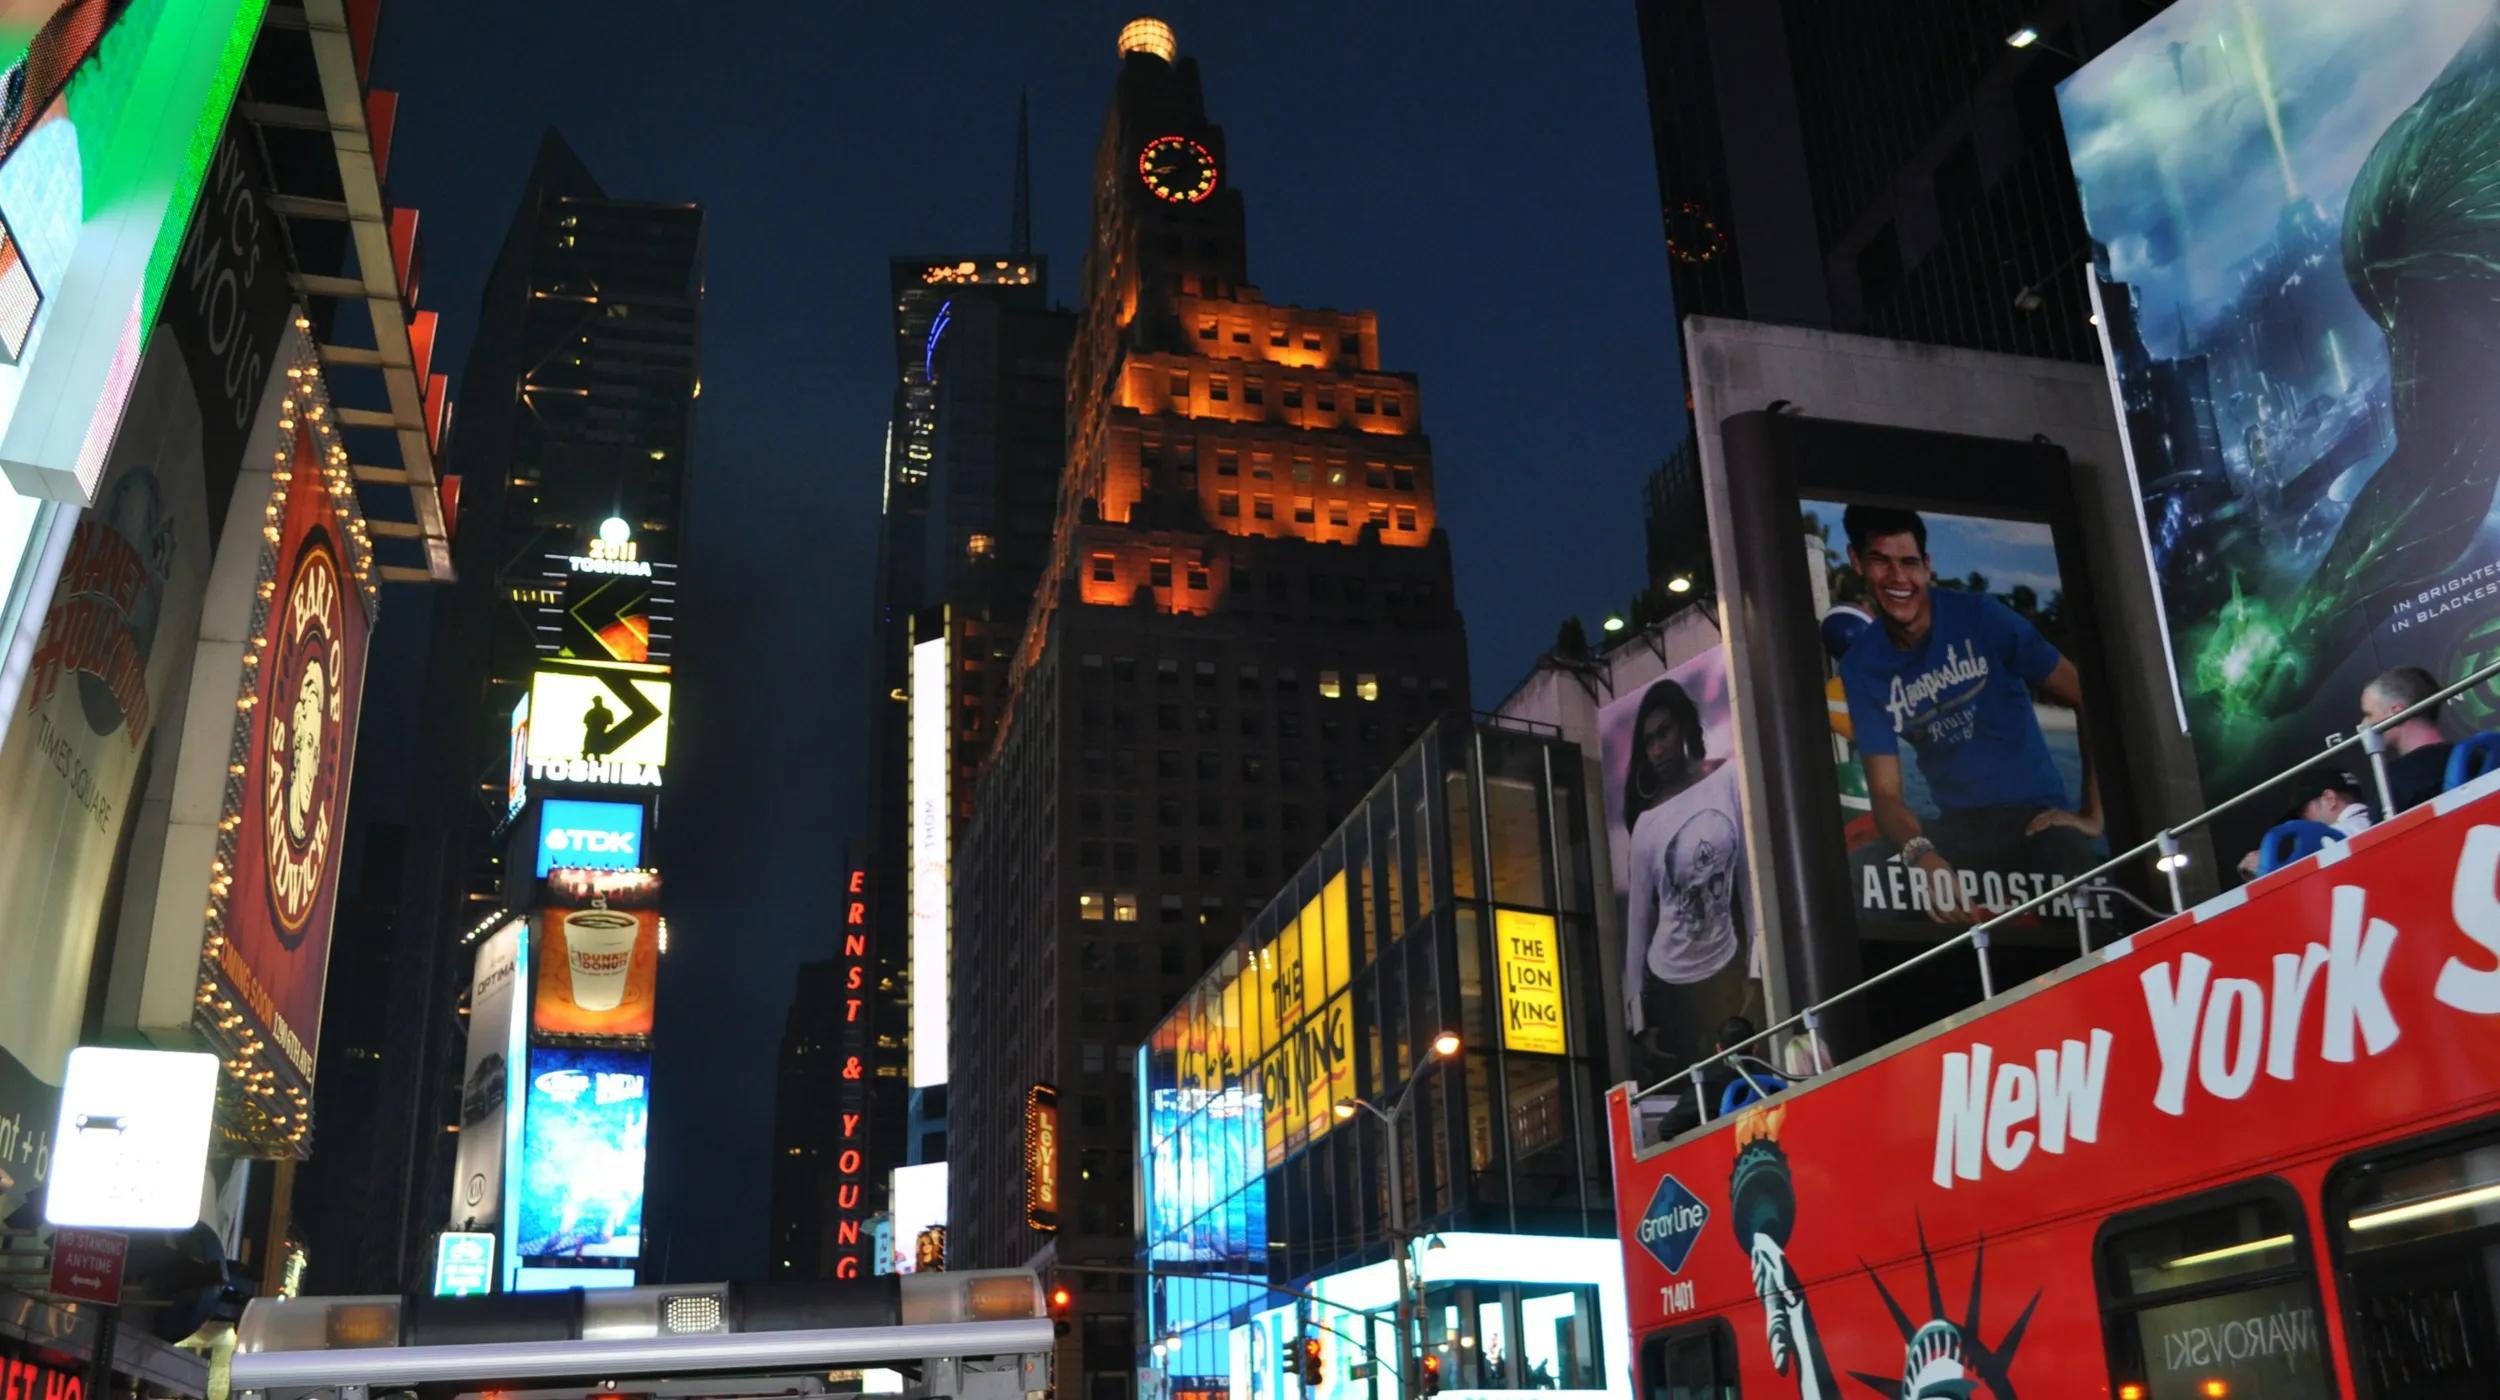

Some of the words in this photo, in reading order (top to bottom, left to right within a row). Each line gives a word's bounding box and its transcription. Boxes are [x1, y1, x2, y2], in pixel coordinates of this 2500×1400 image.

[569, 556, 652, 577] TOSHIBA
[588, 538, 637, 561] 2011
[294, 565, 334, 644] EARL
[2392, 619, 2410, 633] IN
[2417, 579, 2500, 623] BLACKES
[2392, 600, 2411, 614] IN
[38, 713, 73, 779] TIMES
[71, 757, 112, 836] SQUARE
[528, 757, 663, 786] TOSHIBA
[270, 716, 329, 915] SANDWICH
[565, 829, 635, 854] TDK
[1862, 852, 2114, 920] AÉROPOSTAE
[845, 870, 865, 1023] ERNST
[1511, 937, 1545, 958] THE
[477, 960, 515, 996] OPTIMA
[1271, 957, 1302, 1021] THE
[1507, 961, 1553, 994] LION
[1509, 998, 1557, 1032] KING
[1931, 1027, 2114, 1190] New
[2139, 884, 2402, 1116] York
[842, 1055, 863, 1081] &
[61, 1230, 76, 1248] NO
[78, 1233, 123, 1256] STANDING
[64, 1252, 113, 1274] ANYTIME
[1660, 1279, 1696, 1316] 71401
